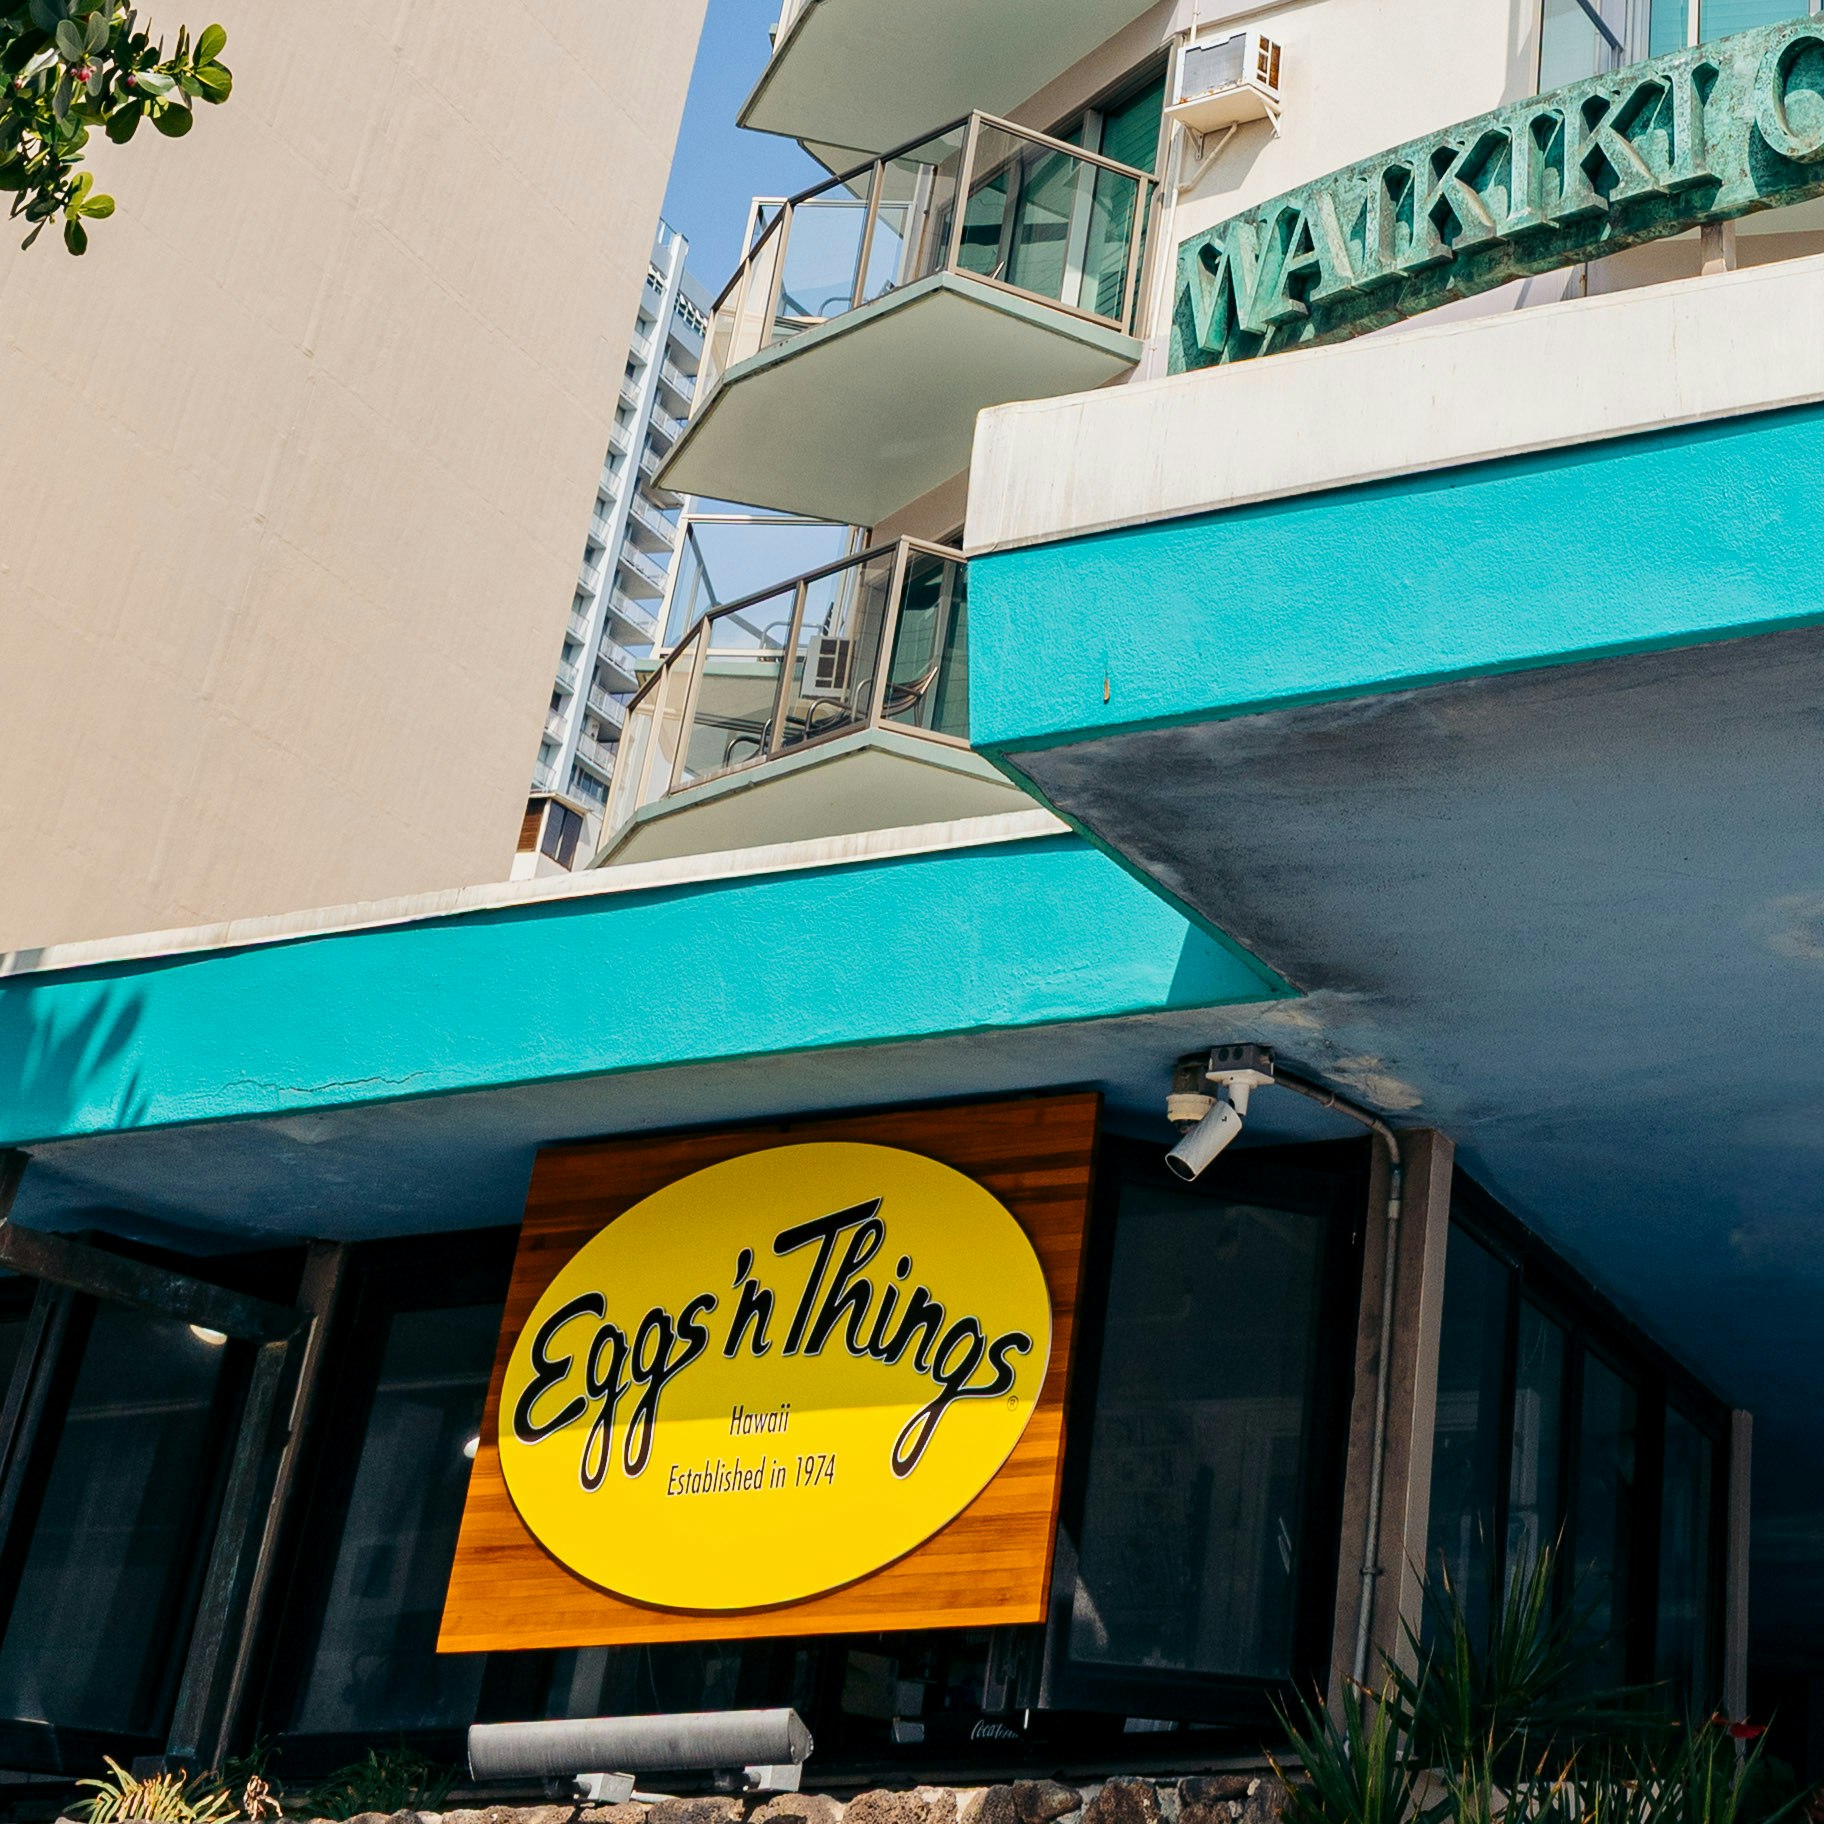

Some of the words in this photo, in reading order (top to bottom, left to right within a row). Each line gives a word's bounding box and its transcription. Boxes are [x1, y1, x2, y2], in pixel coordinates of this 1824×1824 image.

[1179, 59, 1724, 353] WAIKIKI
[513, 1290, 718, 1492] Eggs
[723, 1248, 774, 1359] 'n
[773, 1196, 1033, 1480] Things
[729, 1403, 791, 1437] Hawaii
[667, 1457, 764, 1496] Established
[769, 1461, 786, 1489] in
[795, 1453, 837, 1488] 1974
